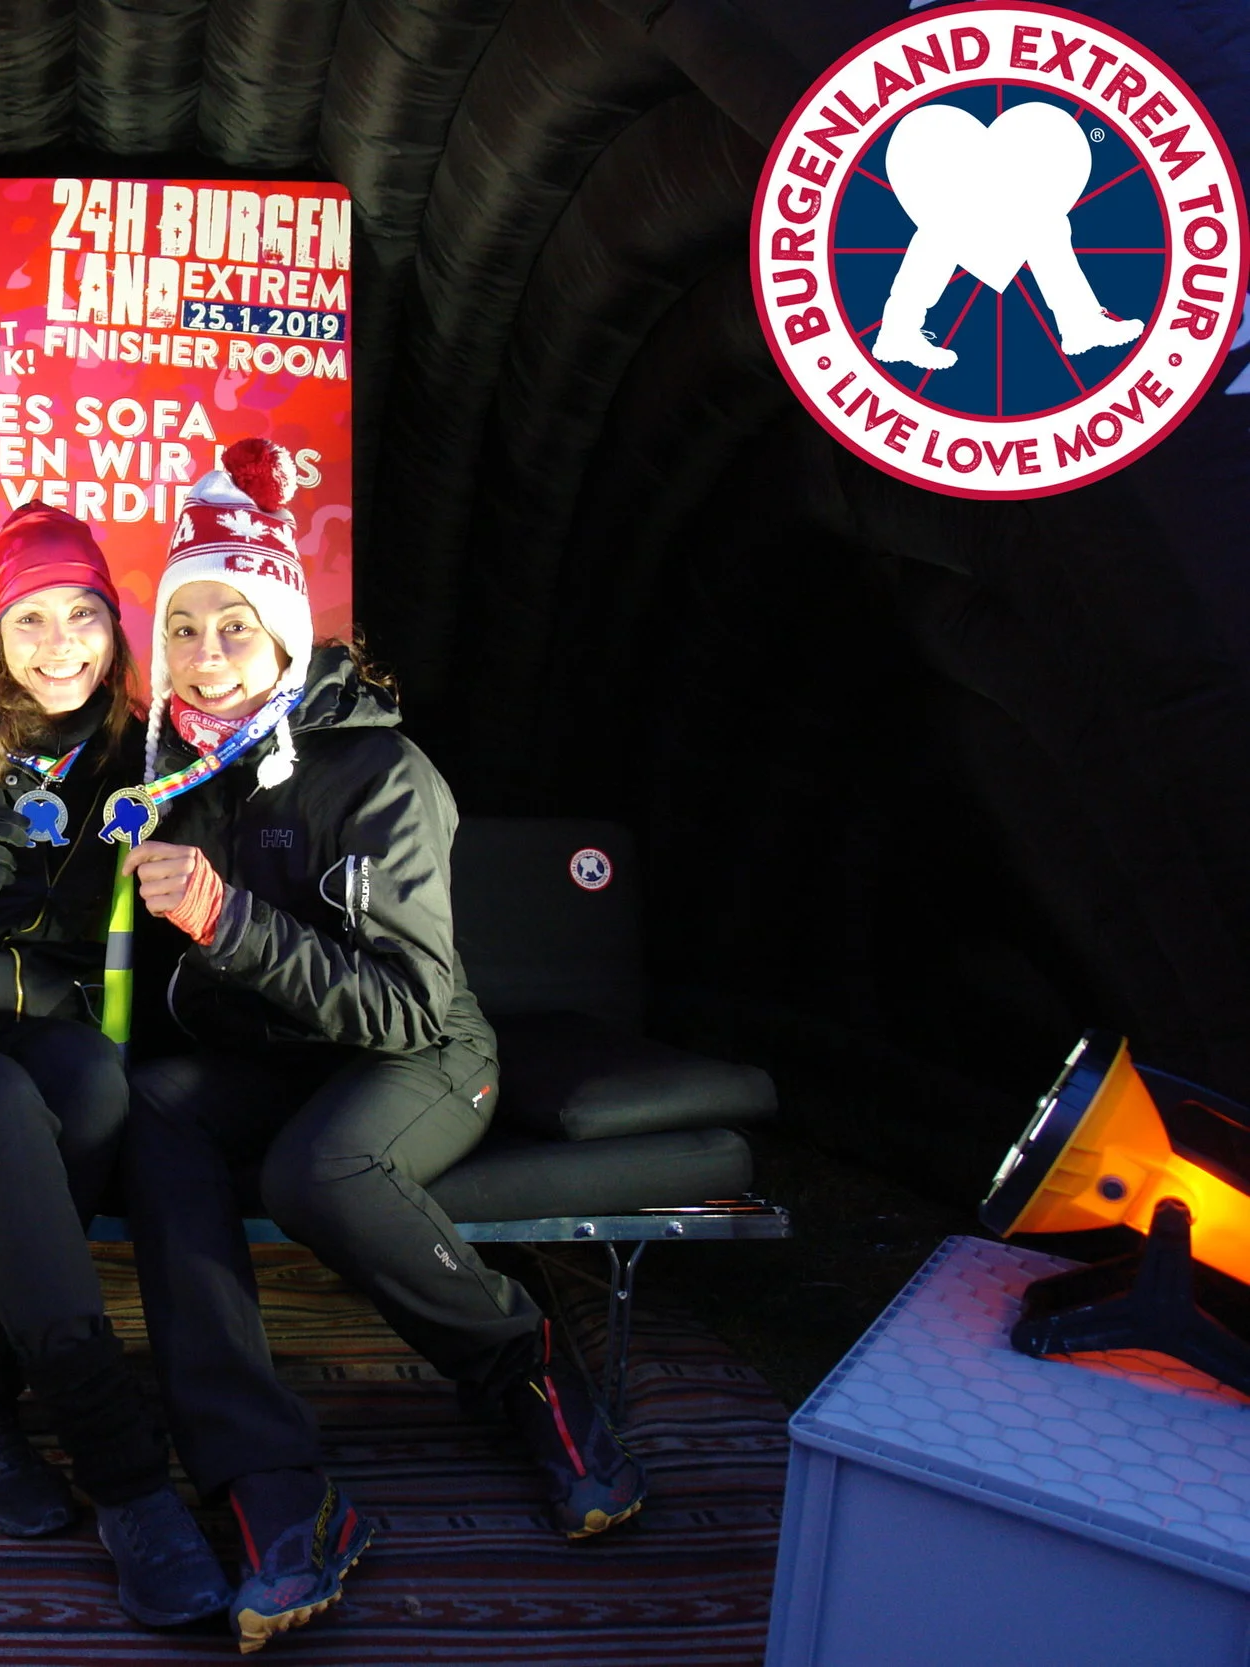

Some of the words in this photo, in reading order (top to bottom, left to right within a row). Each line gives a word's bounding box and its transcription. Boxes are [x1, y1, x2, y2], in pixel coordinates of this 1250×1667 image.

[50, 178, 148, 253] 24H
[157, 185, 352, 271] BURGEN
[46, 250, 180, 329] LAND
[182, 261, 348, 311] EXTREM
[44, 326, 219, 370] FINISHER
[228, 339, 348, 381] ROOM
[74, 395, 216, 442] SOFA
[87, 437, 192, 483] WIR
[260, 828, 294, 849] HH
[433, 1242, 458, 1272] CMP
